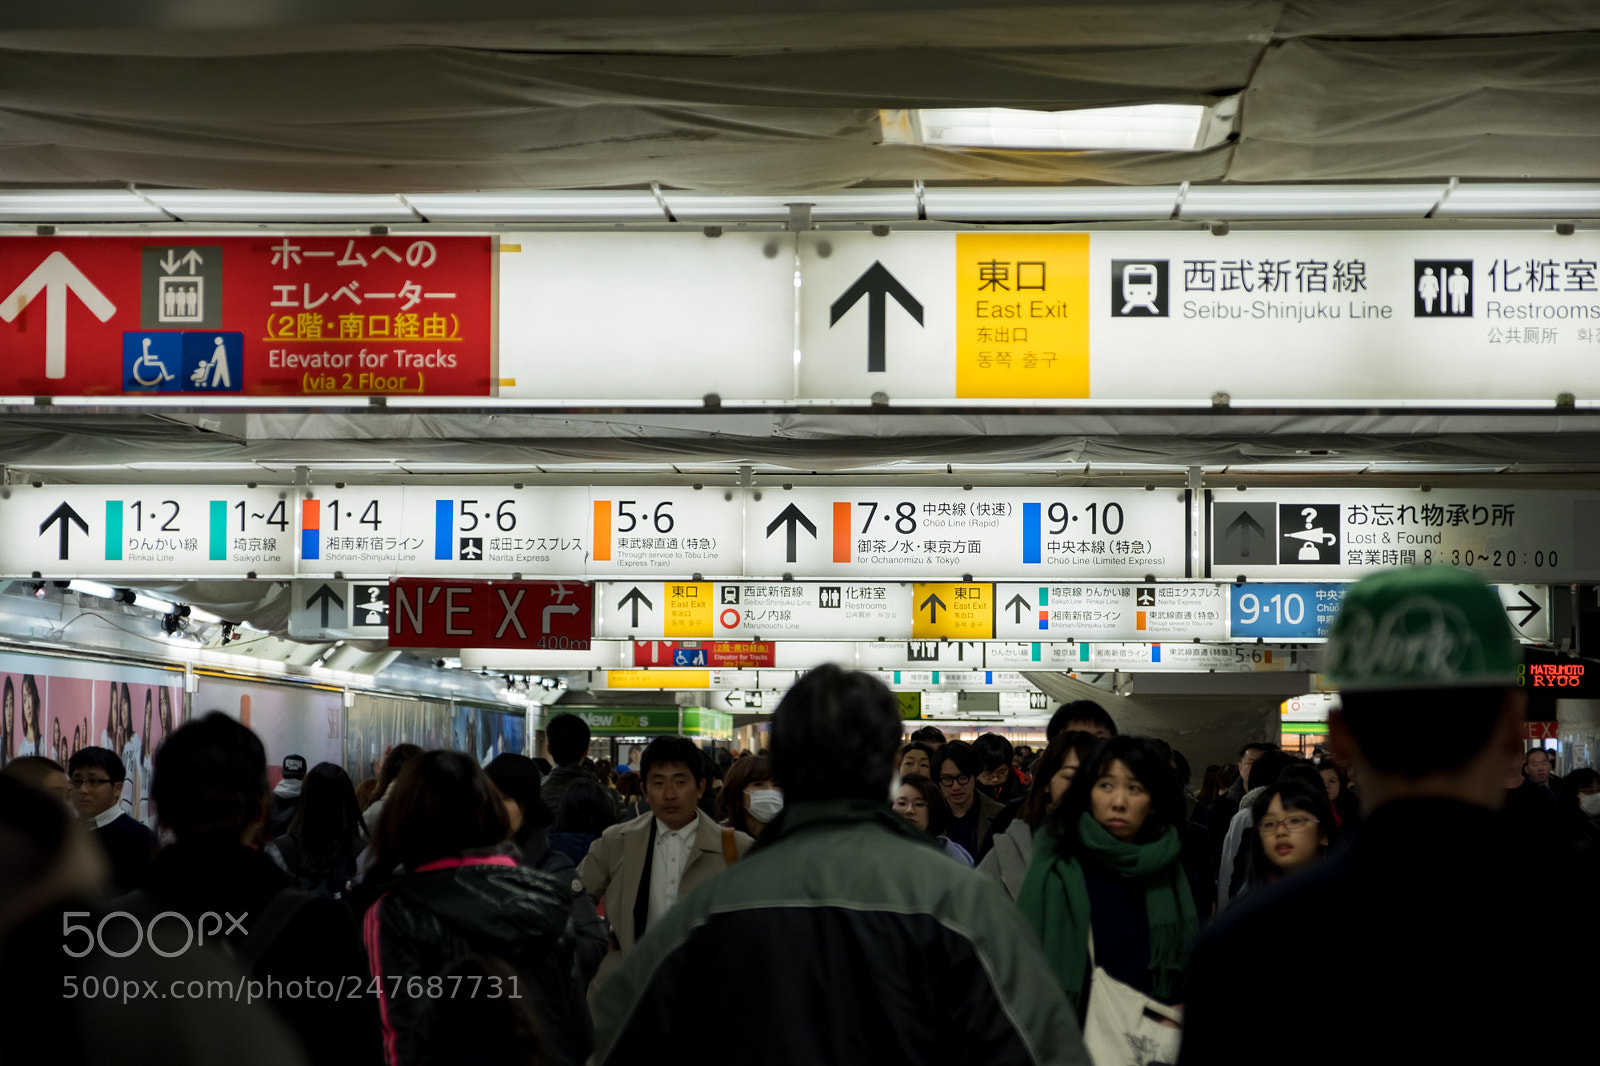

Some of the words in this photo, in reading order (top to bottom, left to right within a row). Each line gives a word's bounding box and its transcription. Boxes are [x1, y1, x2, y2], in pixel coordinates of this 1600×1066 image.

[270, 238, 437, 270] ホームへの
[976, 258, 1047, 292] 東口
[1183, 258, 1367, 293] 西武新宿線
[1488, 258, 1599, 293] 化粧室
[270, 280, 456, 311] エレベーター
[976, 300, 1022, 318] East
[1030, 300, 1068, 318] Exit
[1183, 300, 1341, 322] Seibu-Shinjuku
[1349, 300, 1393, 319] Line
[1486, 301, 1600, 319] Restrooms
[976, 326, 1028, 344] 东出口
[1487, 326, 1558, 344] 公共厕所
[268, 348, 352, 368] Elevator
[359, 348, 388, 368] for
[393, 348, 457, 368] Tracks
[976, 350, 1013, 369] 동쪽
[1022, 350, 1058, 369] 출구
[302, 372, 336, 393] (via
[342, 374, 352, 389] 2
[359, 372, 407, 390] Floor
[234, 500, 290, 532] 1~4
[1347, 503, 1516, 527] お忘れ物承り所
[948, 518, 966, 528] Line
[968, 518, 1000, 528] (Rapid)
[326, 536, 424, 551] 湘南新宿ライン
[1347, 531, 1376, 544] Lost
[1381, 532, 1392, 544] &
[1397, 531, 1442, 544] Found
[129, 537, 198, 552] りんかい線
[233, 537, 277, 552] 埼京線
[489, 538, 582, 551] 成田エクスプレス
[128, 553, 154, 562] Rinkai
[156, 553, 174, 562] Line
[264, 553, 281, 562] Line
[398, 552, 416, 562] Line
[488, 553, 514, 562] Narita
[516, 553, 550, 563] Express
[617, 551, 646, 560] Through
[702, 551, 718, 559] Line
[858, 556, 869, 564] for
[871, 556, 924, 564] Ochanomizu
[926, 556, 932, 564] &
[1072, 556, 1090, 565] Line
[1092, 556, 1126, 566] (Limited
[1128, 556, 1166, 566] Express)
[1347, 550, 1416, 566] 営業時間
[616, 559, 648, 568] (Express
[650, 559, 671, 568] Train)
[672, 586, 698, 598] 東口
[744, 586, 804, 598] 西武新宿線
[846, 586, 886, 600] 化粧室
[954, 587, 981, 600] 東口
[1052, 588, 1083, 598] 埼京線
[1086, 588, 1131, 598] りんかい線
[1158, 588, 1221, 598] 成田エクスプレス
[671, 600, 690, 608] East
[691, 600, 706, 608] Exit
[844, 602, 887, 610] Restrooms
[954, 602, 970, 610] East
[972, 602, 987, 610] Exit
[744, 610, 792, 621] 丸ノ内線
[1052, 610, 1121, 621] 湘南新宿ライン
[744, 622, 784, 630] Marunouchi
[786, 622, 800, 630] Line
[536, 636, 588, 650] 400m
[1530, 664, 1584, 676] MATSUMOTO
[579, 712, 649, 729] NewDays
